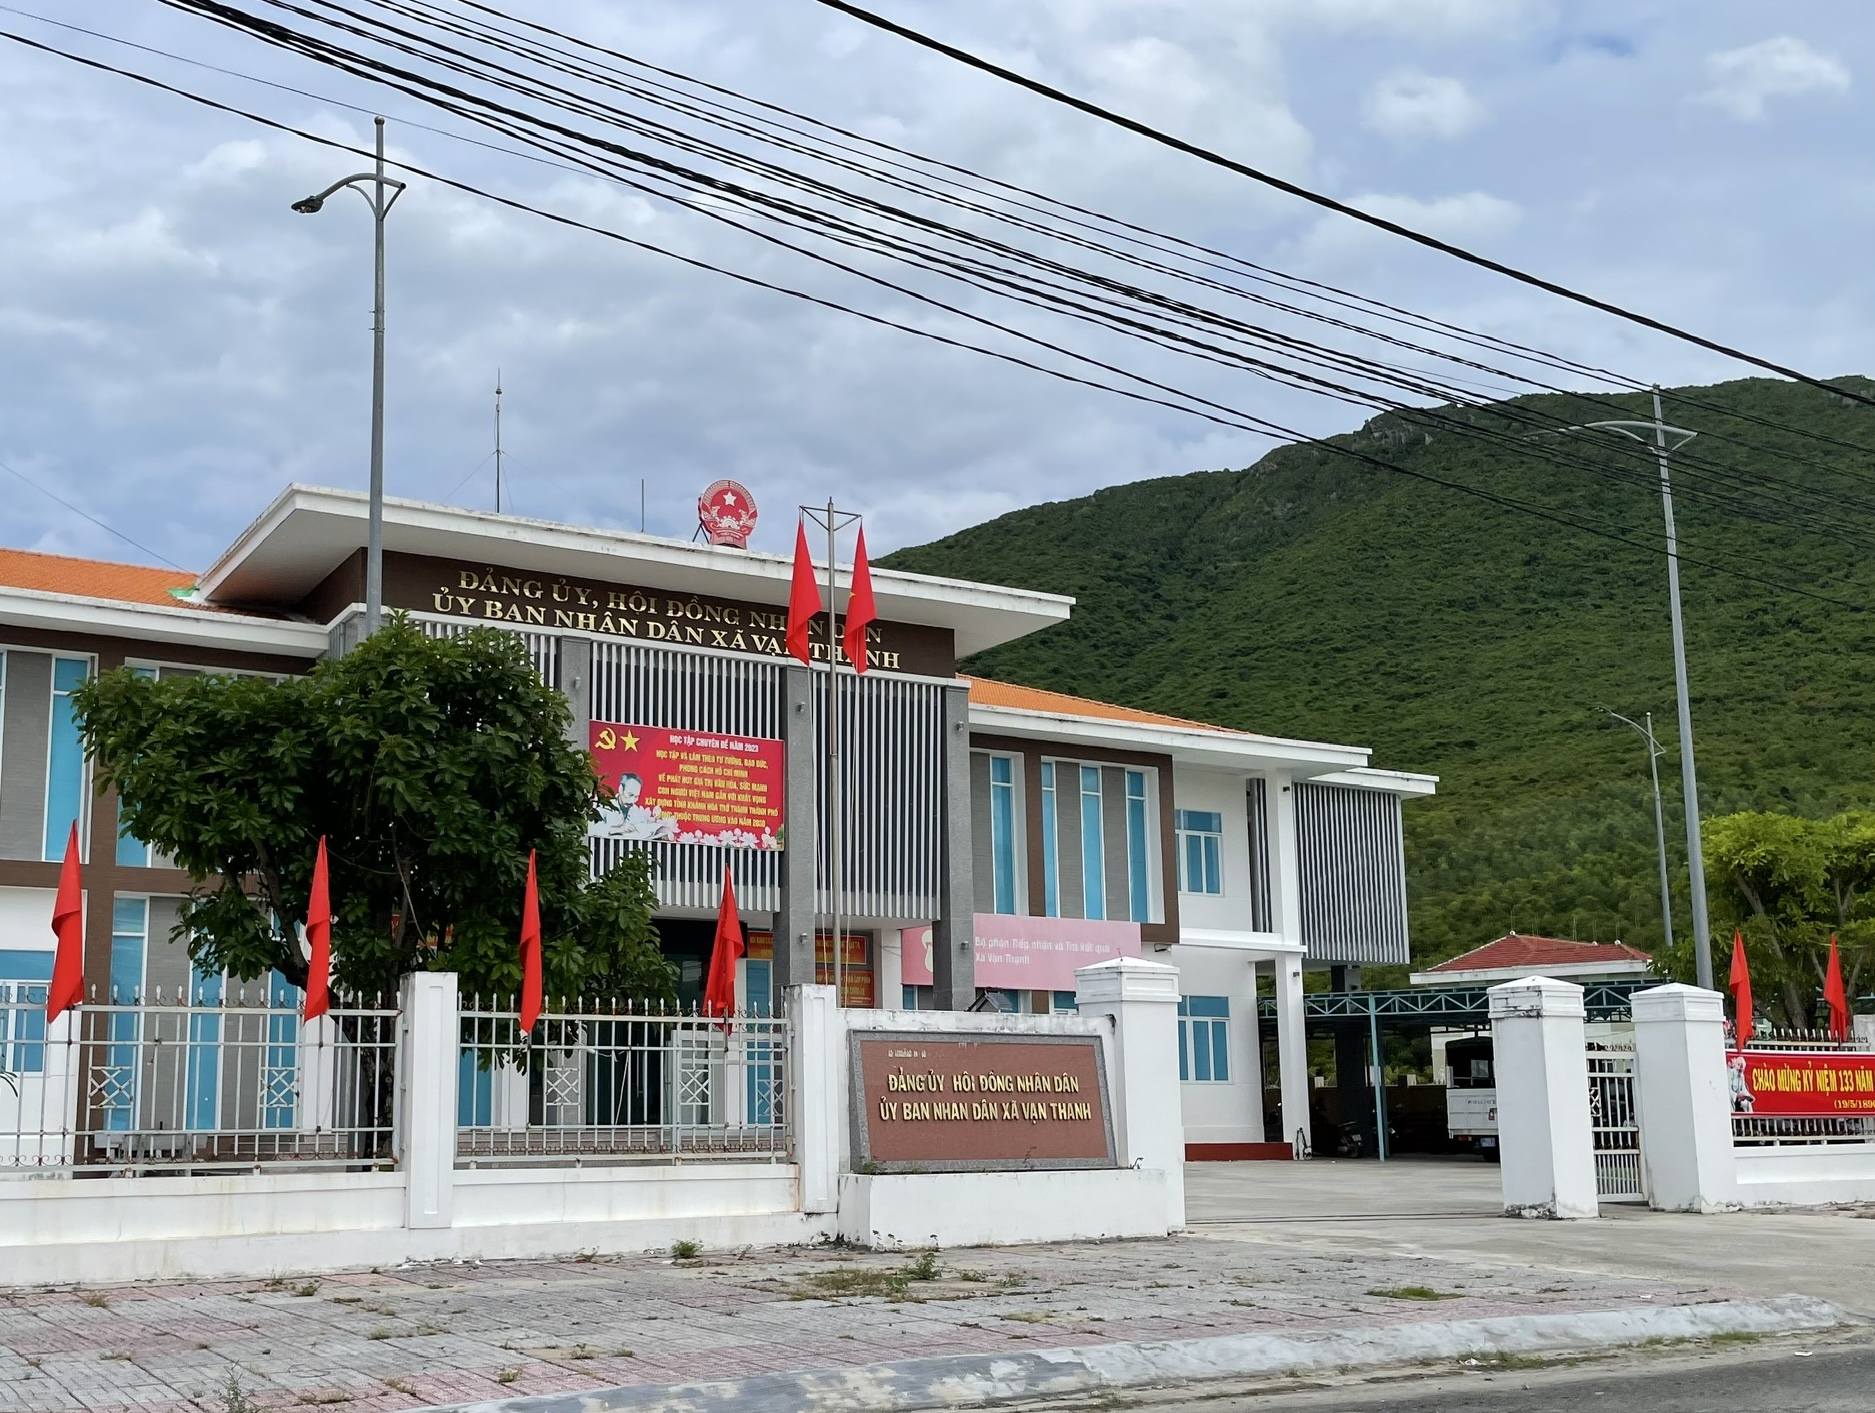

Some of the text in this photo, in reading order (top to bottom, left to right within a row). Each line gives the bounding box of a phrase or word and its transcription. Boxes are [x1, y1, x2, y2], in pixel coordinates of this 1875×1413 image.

[458, 567, 543, 599] ĐẢNG
[551, 578, 599, 609] ỦY,
[607, 591, 658, 615] HỘI
[666, 595, 740, 625] ĐỒNG
[749, 611, 824, 637] NHN
[432, 586, 900, 669] ỦY BAN NHÂN DÂN XÃ VẠ THNH
[656, 750, 668, 759] HỌC
[669, 750, 680, 760] TẬP
[680, 751, 688, 760] VÀ
[702, 754, 715, 763] THEO
[669, 735, 759, 752] HỌC TẬP CHUYÊN ĐỀ NĂM 2023
[679, 764, 698, 773] PHONG
[699, 765, 714, 774] CÁCH
[723, 767, 733, 776] CHÍ
[734, 769, 749, 778] MINH
[888, 1066, 925, 1092] ĐẢNG
[927, 1068, 944, 1092] ỦY
[1016, 1071, 1051, 1092] NHÂN
[1053, 1072, 1079, 1092] DÂN
[1752, 1060, 1874, 1097] CHÀO MỪNG KỶ NIỆM 133 NĂM
[880, 1095, 897, 1120] ỦY
[903, 1102, 930, 1120] BAN
[972, 1098, 998, 1120] DÂN
[1001, 1099, 1019, 1120] XÃ
[1021, 1102, 1047, 1124] VẠN
